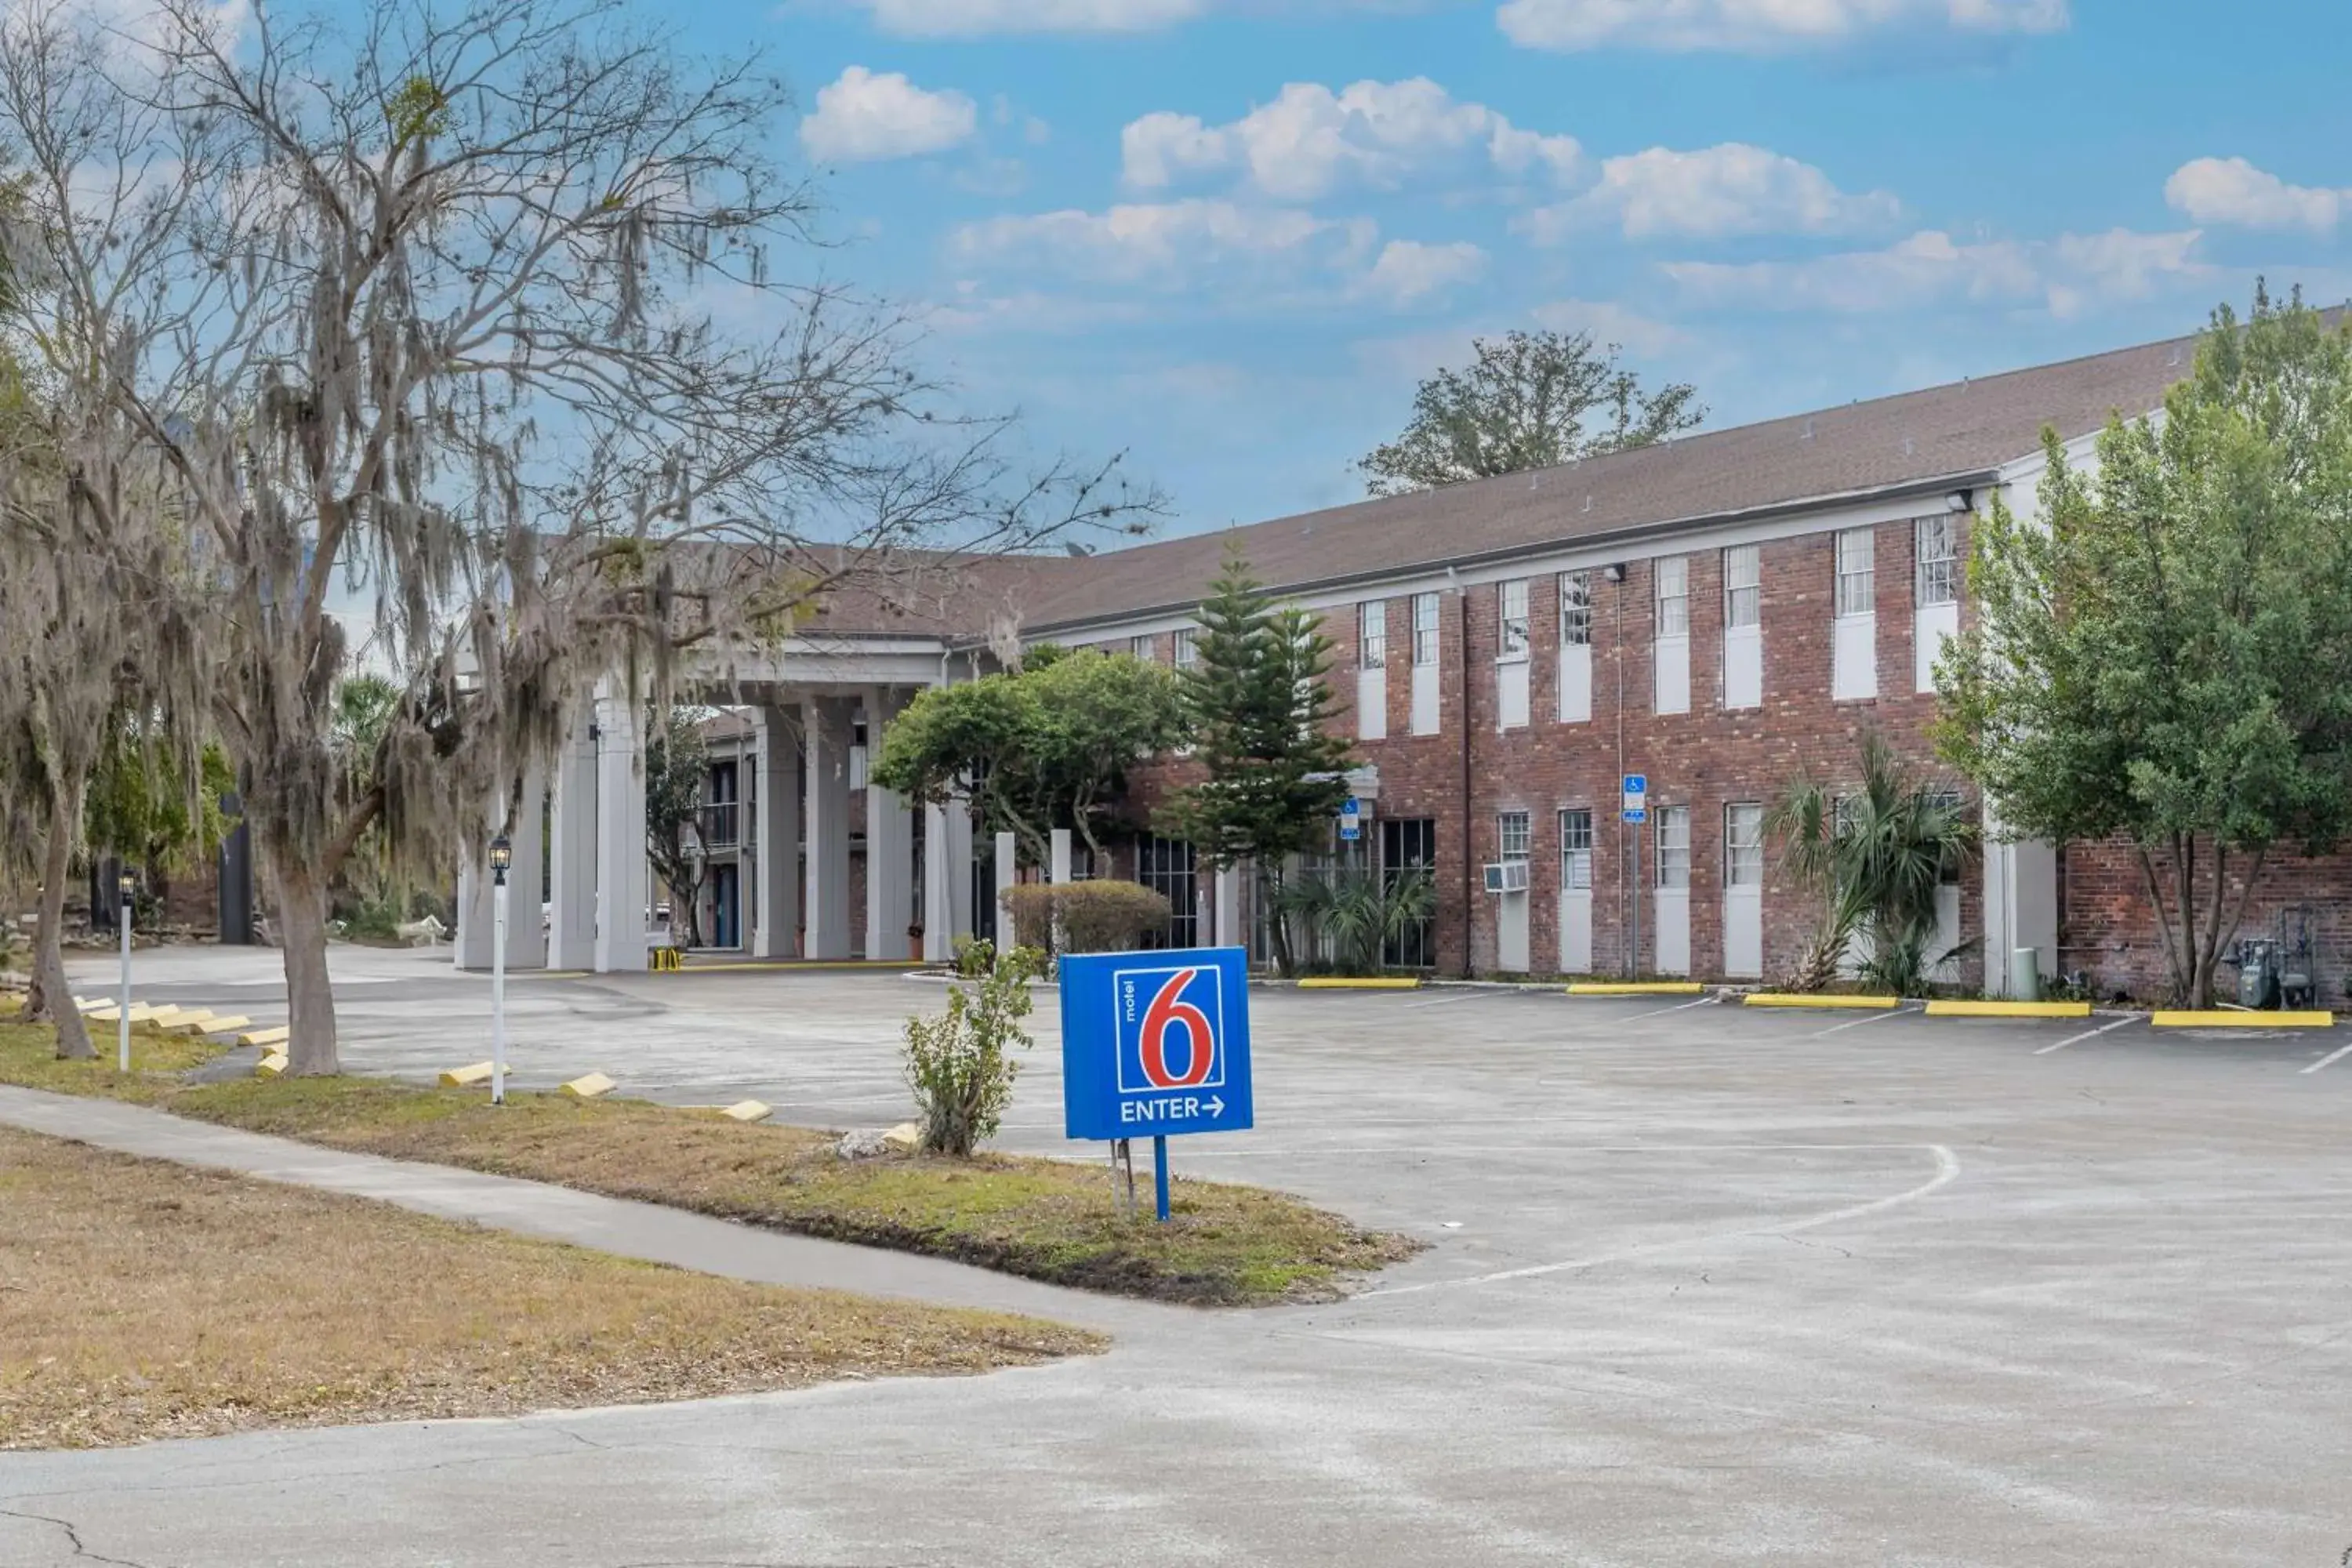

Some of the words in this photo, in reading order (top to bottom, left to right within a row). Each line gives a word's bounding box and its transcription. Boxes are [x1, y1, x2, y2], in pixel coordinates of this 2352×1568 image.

[1123, 980, 1135, 1022] motel
[1139, 968, 1214, 1088] 6
[1120, 1097, 1200, 1122] ENTER
